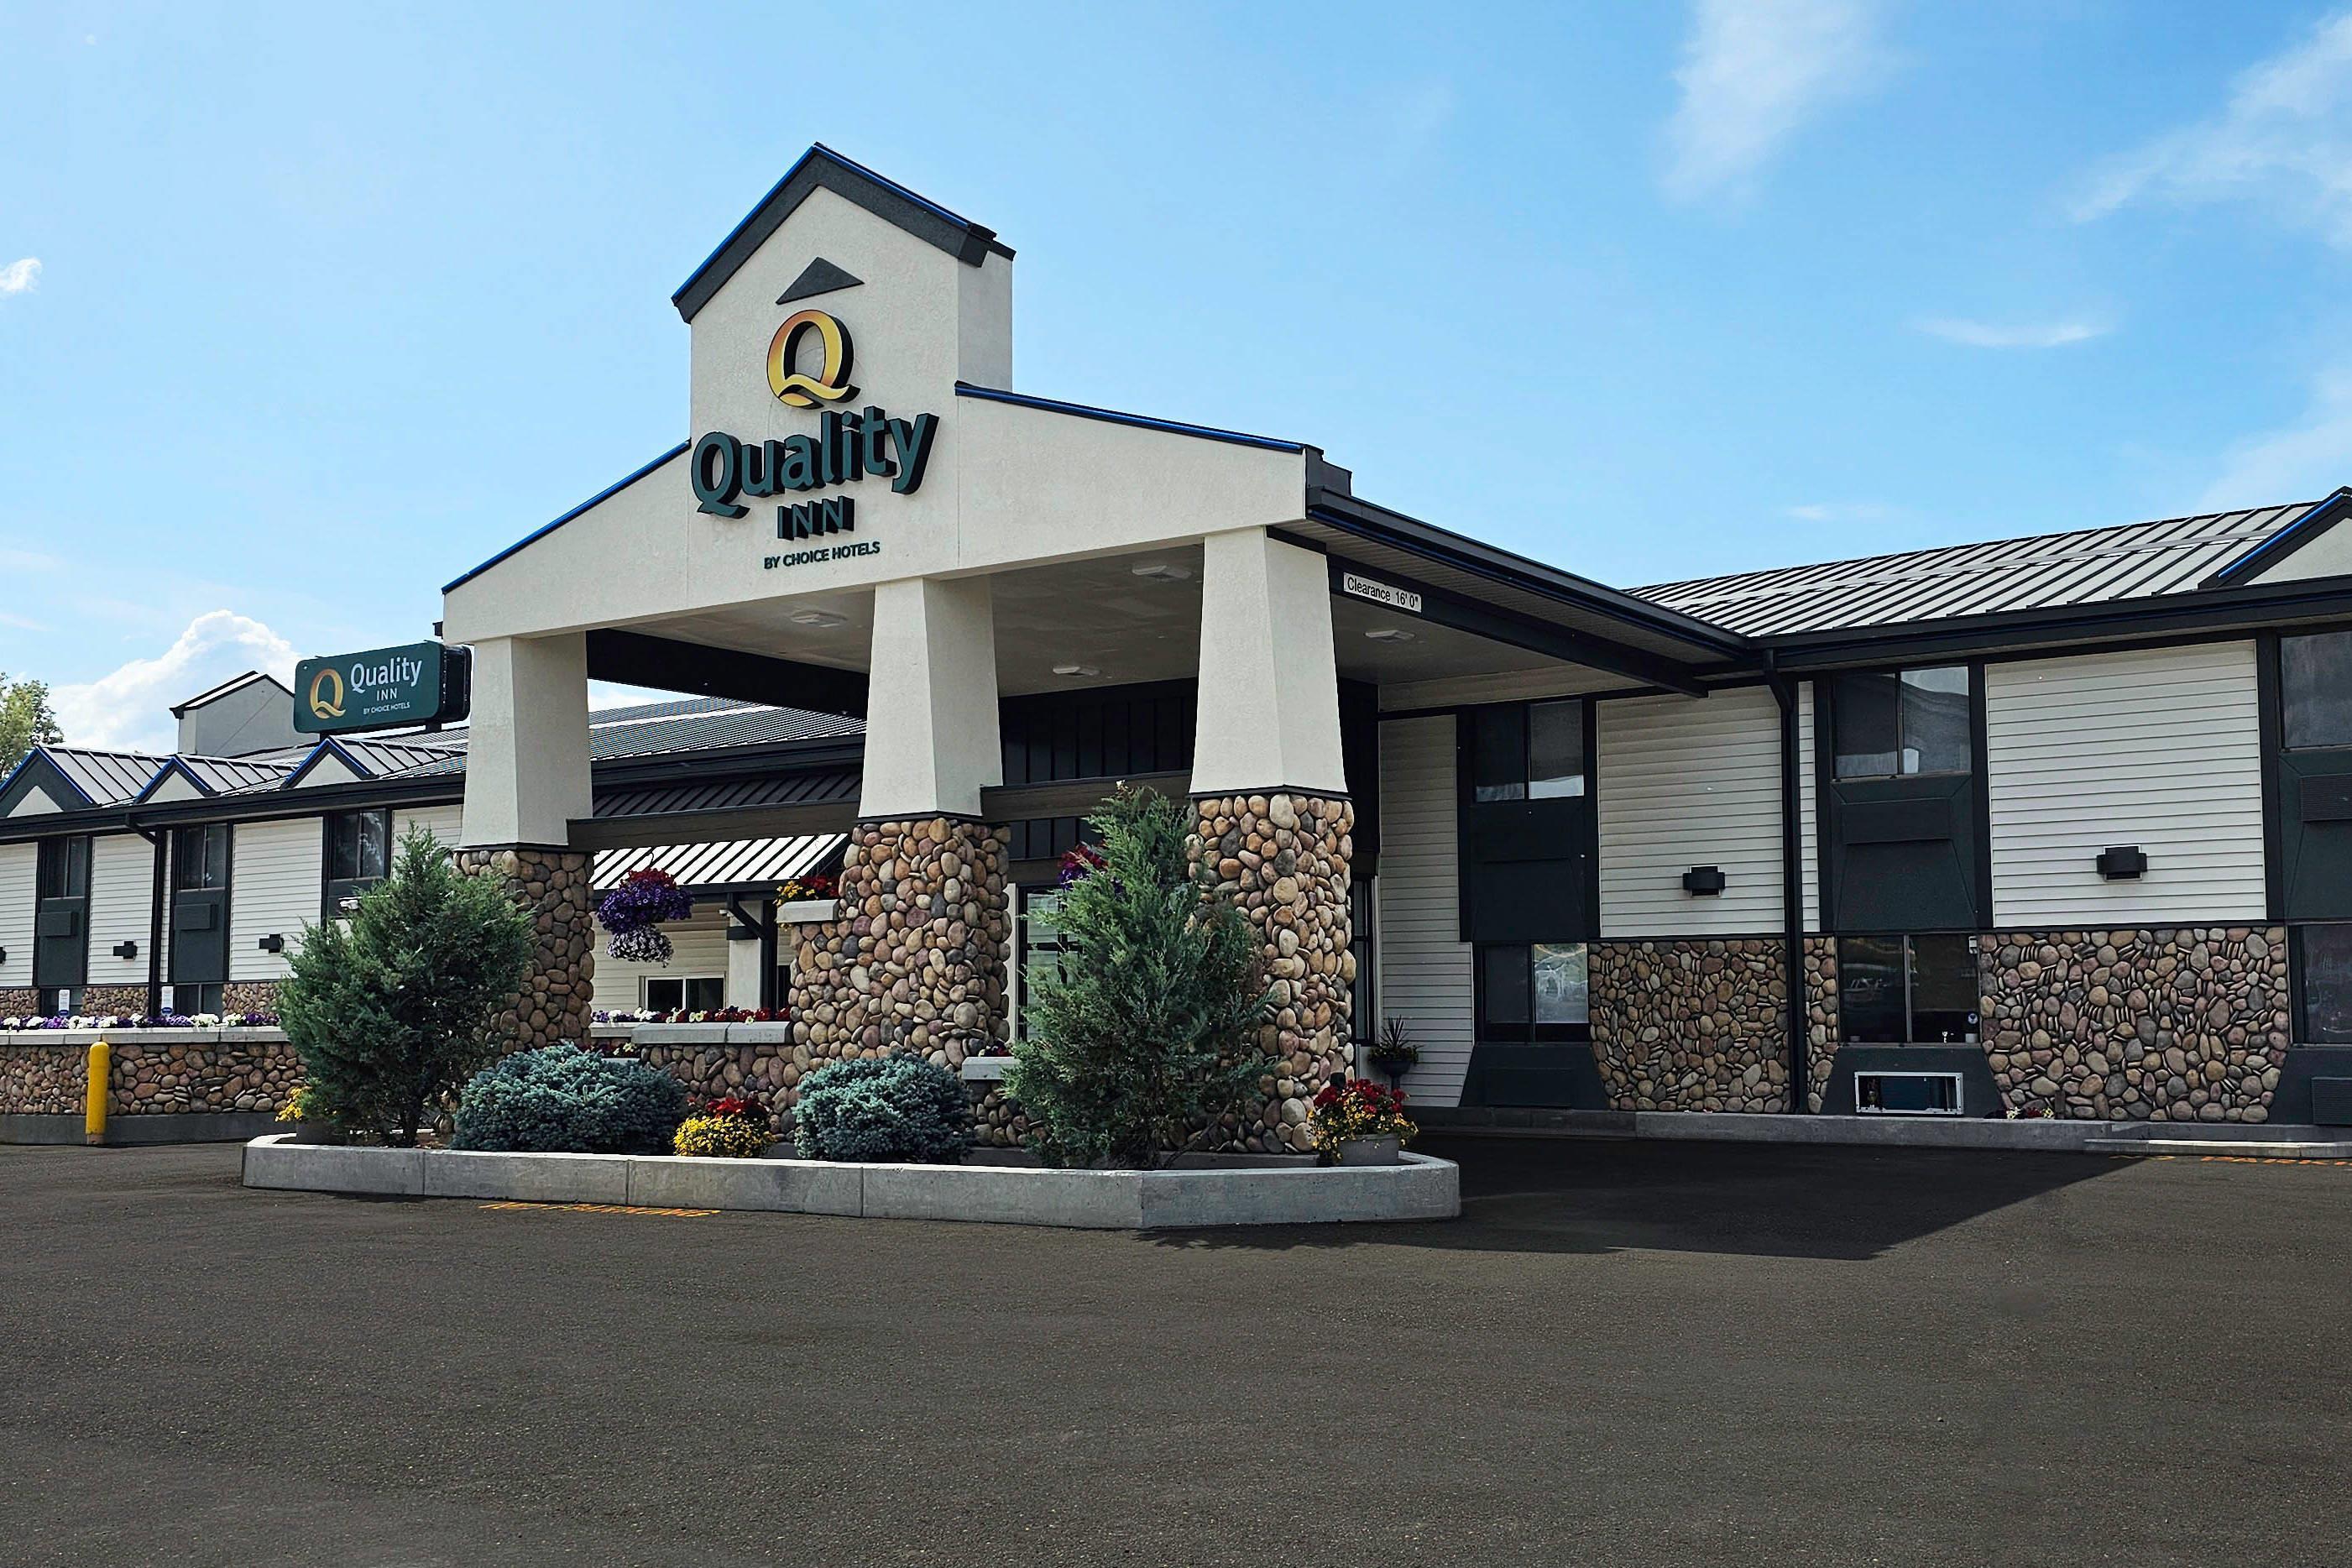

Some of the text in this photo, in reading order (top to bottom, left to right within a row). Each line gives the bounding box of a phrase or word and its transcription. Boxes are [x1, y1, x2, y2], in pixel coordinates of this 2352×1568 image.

[766, 309, 861, 410] Q
[691, 405, 940, 519] Quality
[777, 495, 855, 541] INN
[764, 541, 881, 570] BY CHOICE HOTELS
[1347, 577, 1391, 602] Clearance
[310, 668, 347, 719] Q
[350, 656, 422, 693] Quality
[377, 687, 398, 701] INN
